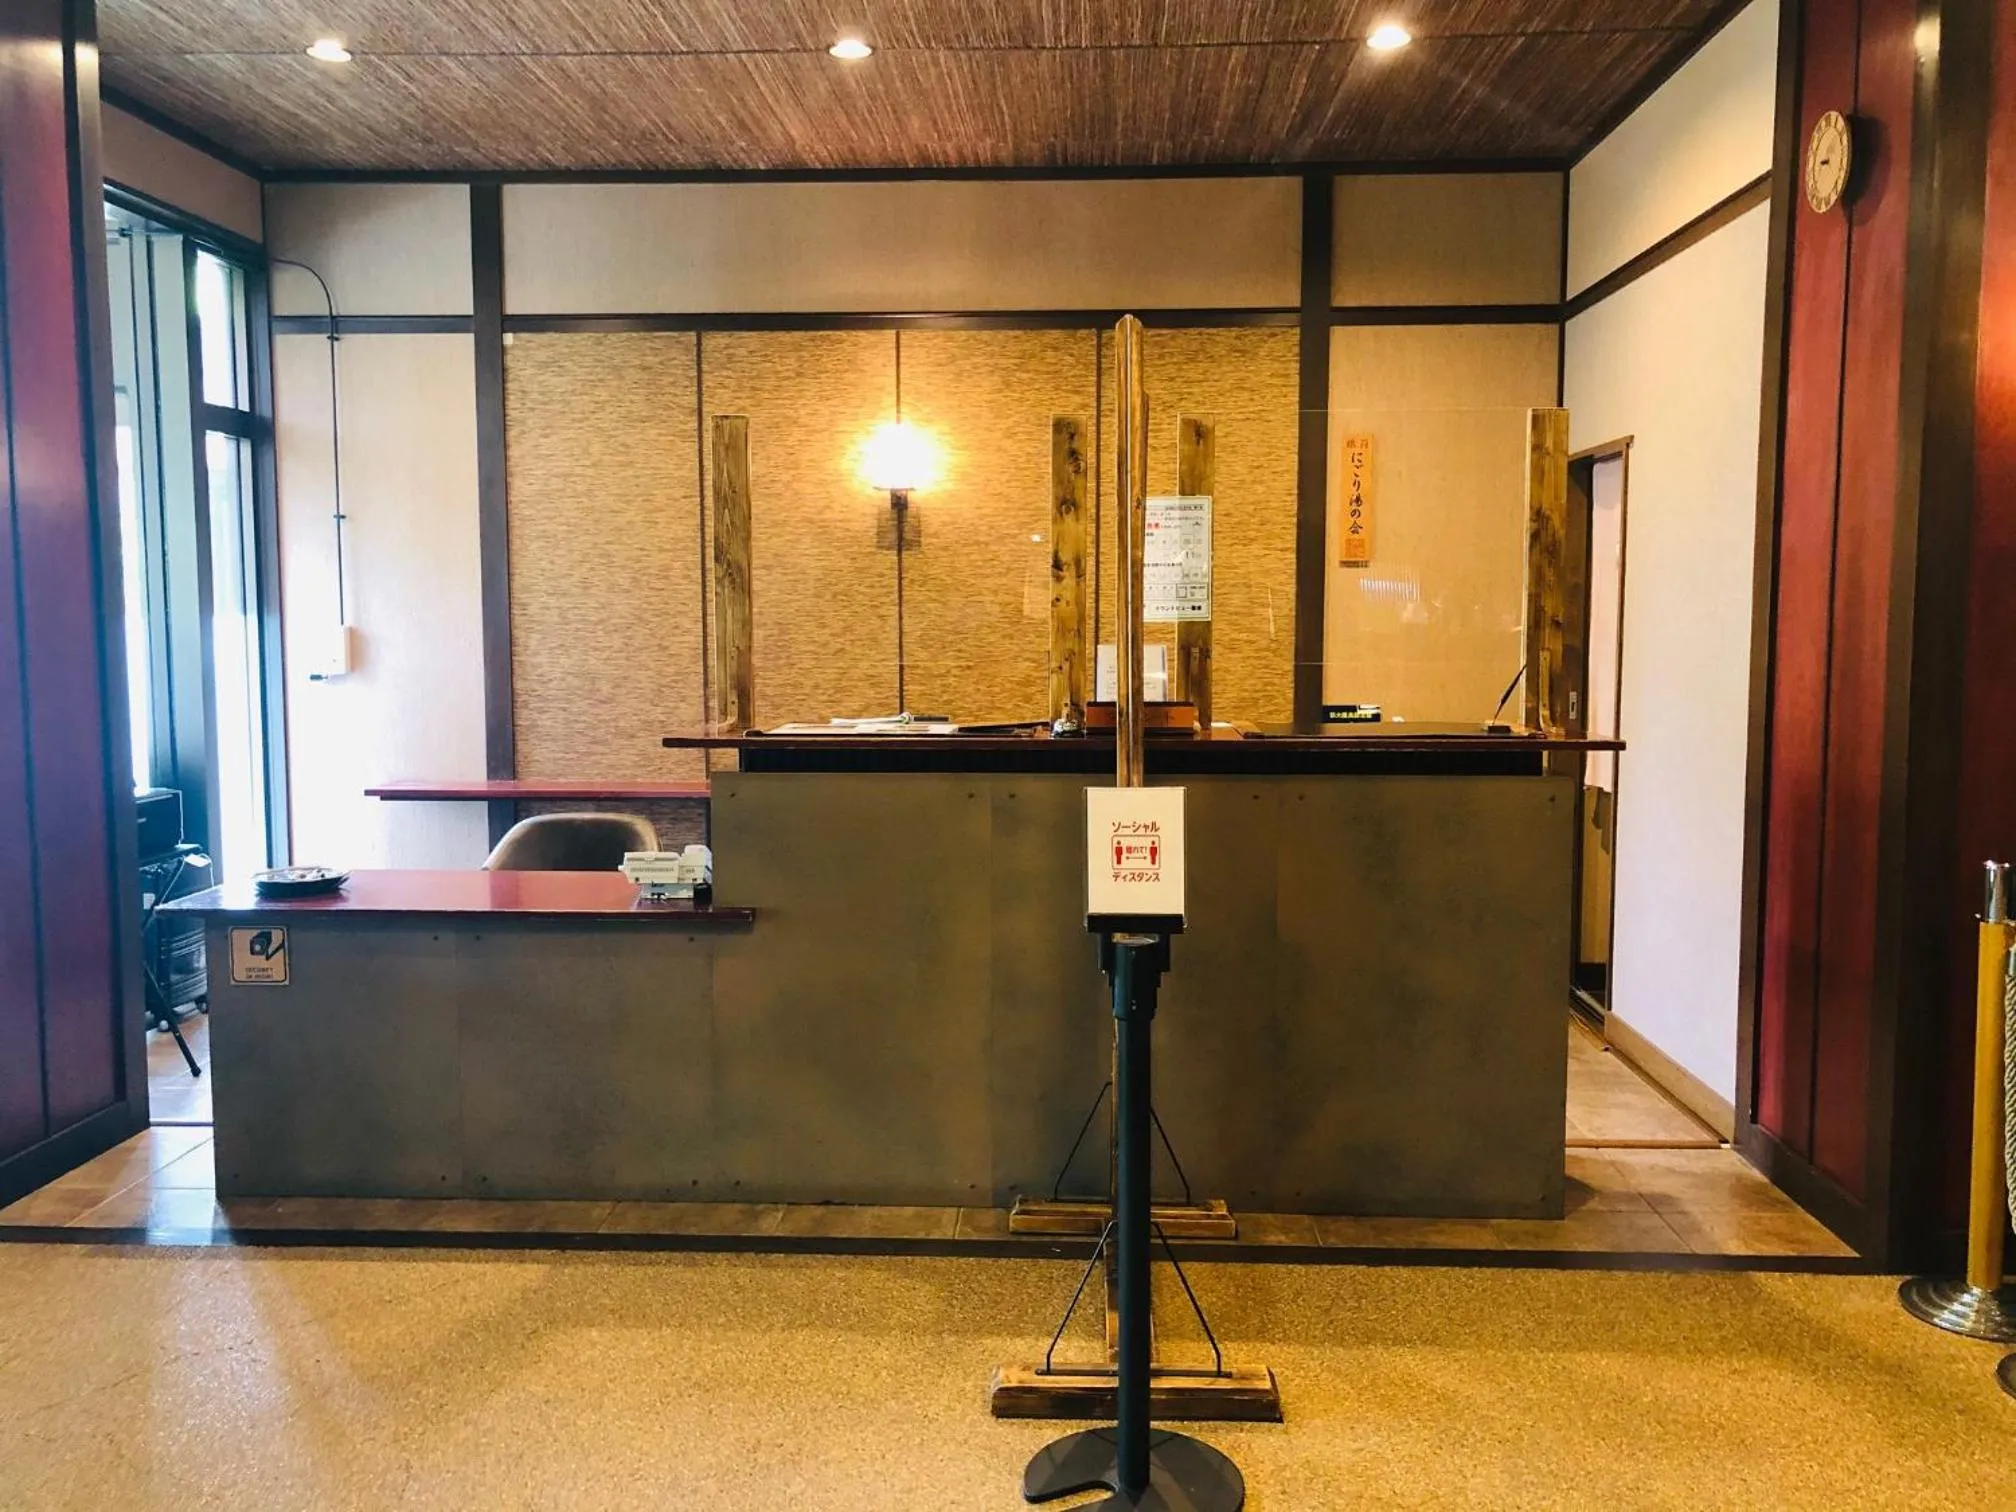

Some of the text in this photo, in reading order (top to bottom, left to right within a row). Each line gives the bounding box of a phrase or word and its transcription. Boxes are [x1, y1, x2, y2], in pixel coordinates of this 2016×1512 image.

[1349, 452, 1364, 535] にごり湯の会
[1112, 821, 1160, 833] ソーシャル
[1112, 872, 1160, 882] ディスタンス
